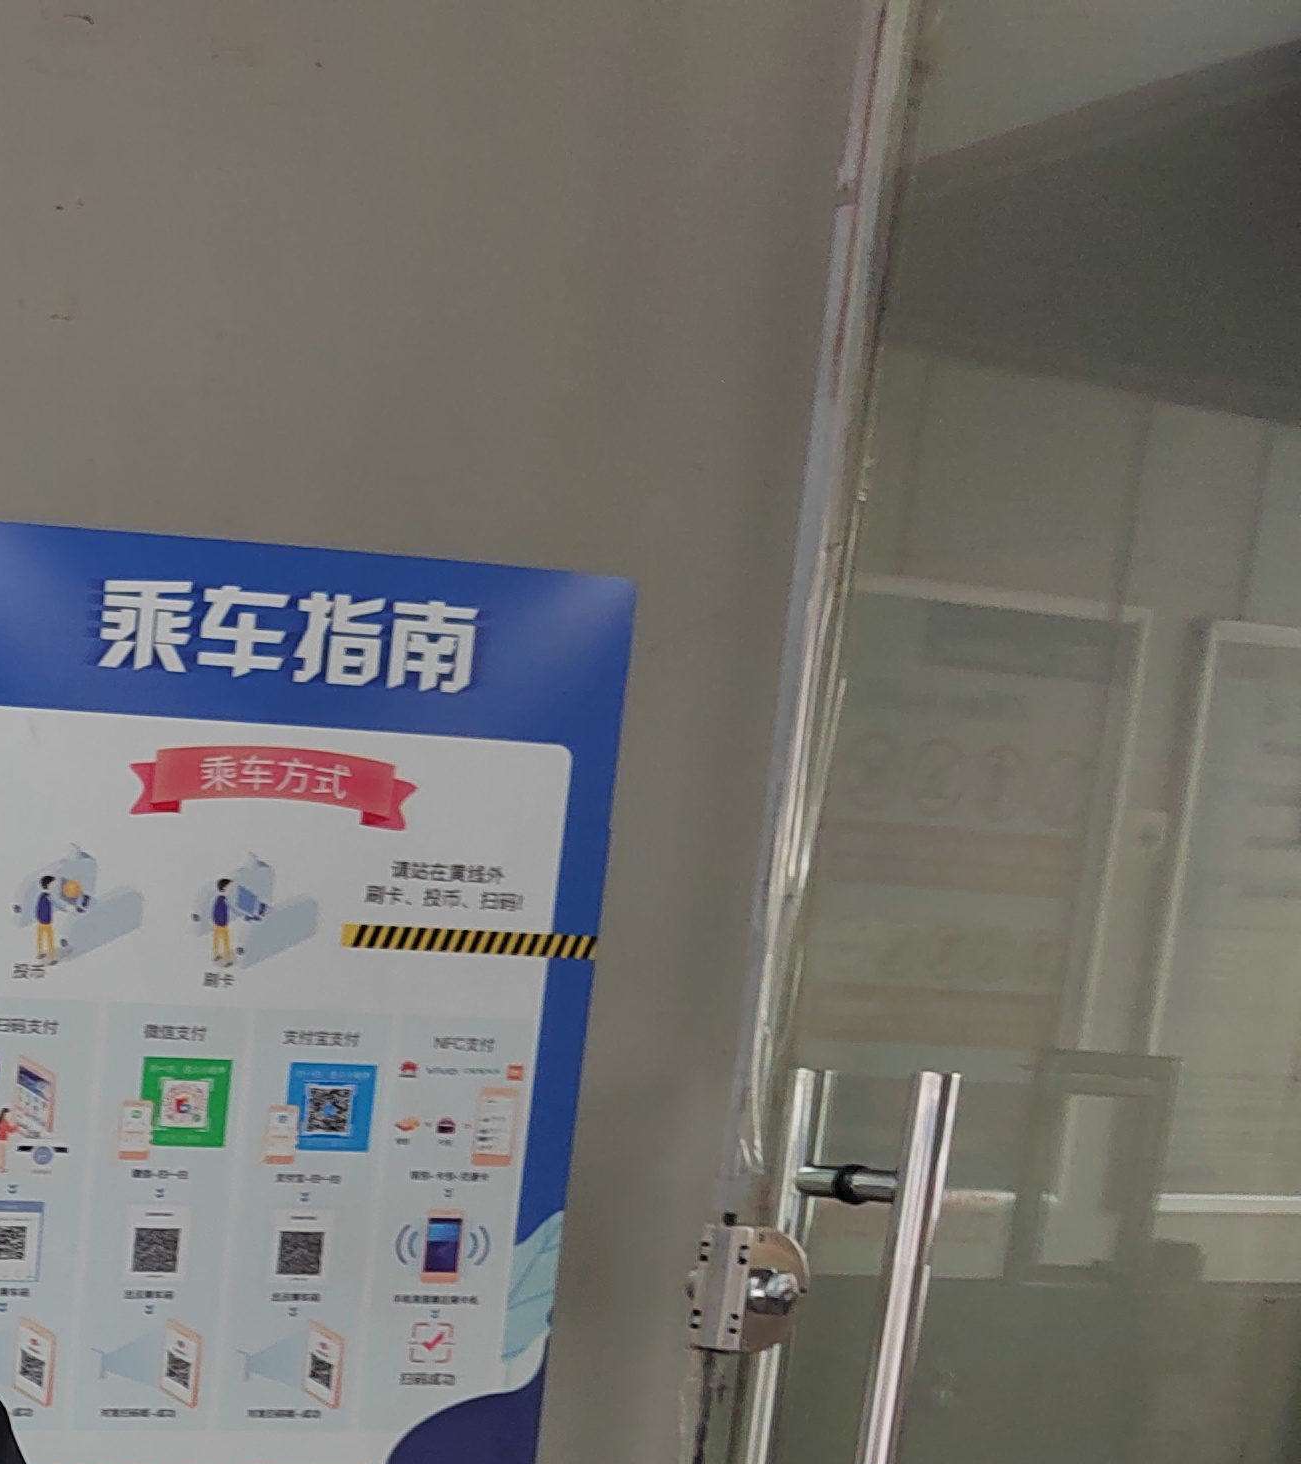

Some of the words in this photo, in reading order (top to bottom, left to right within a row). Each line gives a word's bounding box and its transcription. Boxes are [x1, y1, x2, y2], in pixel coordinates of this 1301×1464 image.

[97, 579, 480, 692] 乘车指南
[199, 754, 352, 799] 乘车方式
[391, 860, 506, 885] 请站在黄线外
[12, 963, 46, 979] 投币
[203, 971, 236, 988] 刷卡
[143, 1023, 208, 1041] 微信支付
[282, 1030, 361, 1048] 支付宝支付
[432, 1036, 496, 1053] NFC支付
[399, 1372, 456, 1387] 扫码成功
